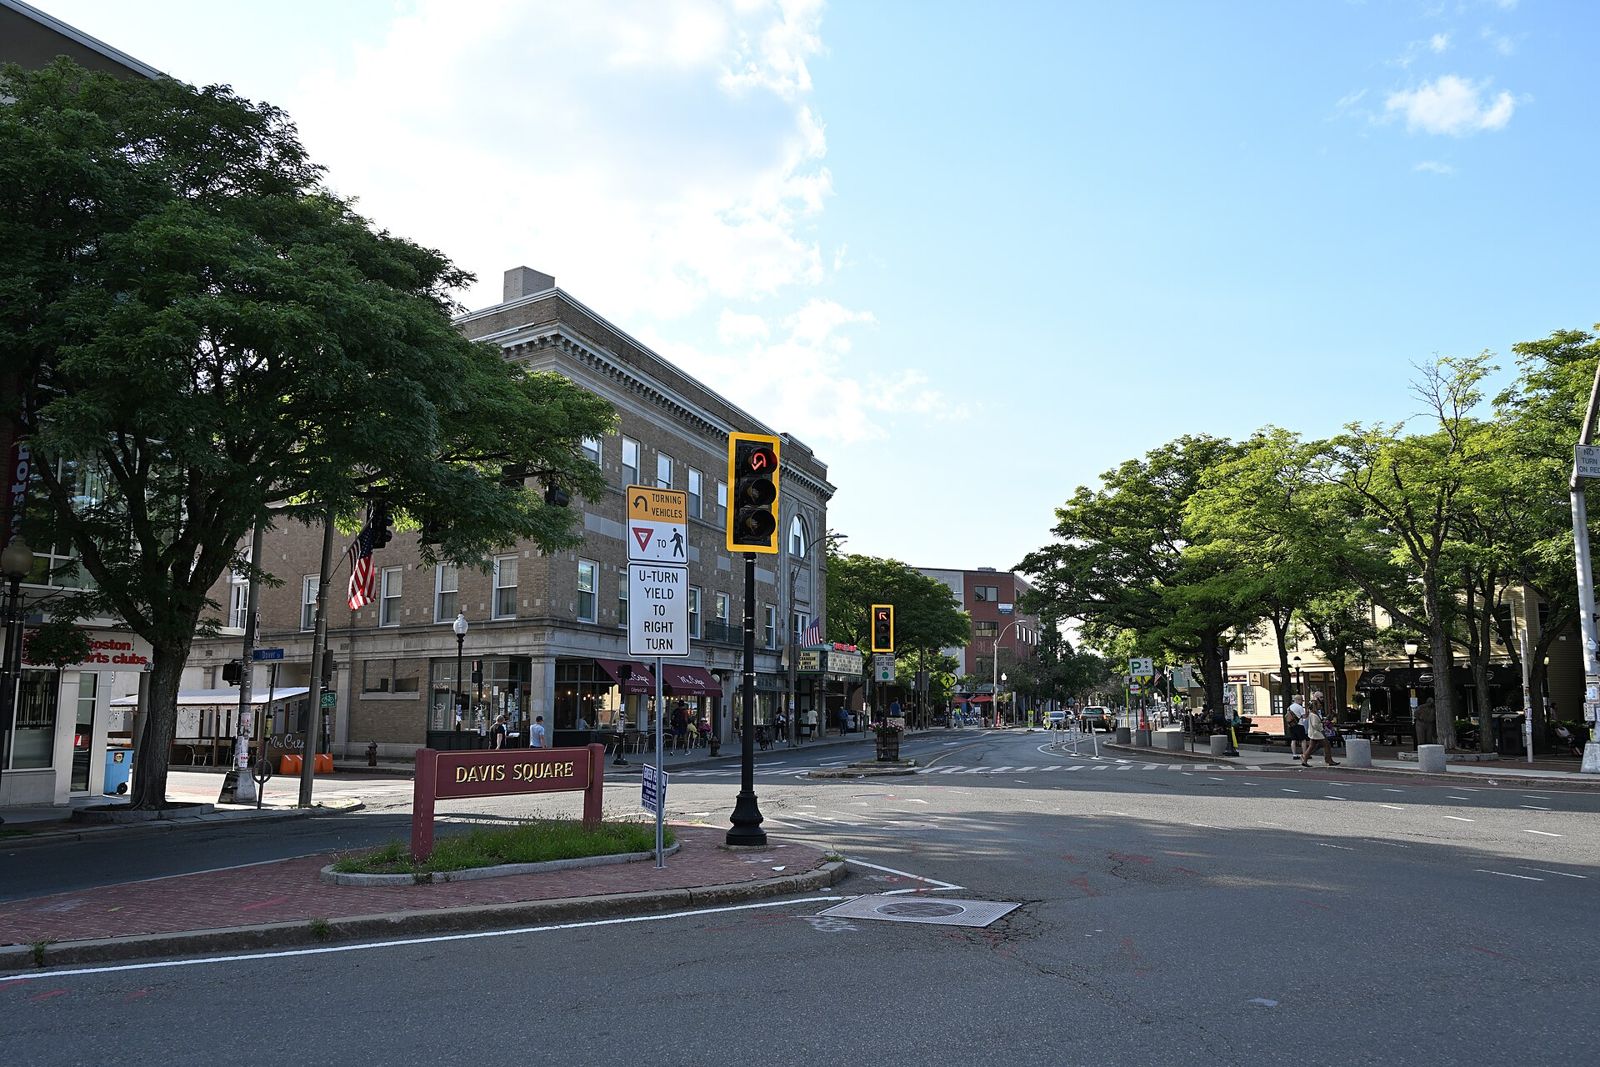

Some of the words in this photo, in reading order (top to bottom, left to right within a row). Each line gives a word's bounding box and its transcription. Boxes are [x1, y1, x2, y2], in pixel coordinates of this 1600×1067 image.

[1583, 448, 1594, 456] NO
[1582, 457, 1598, 465] TURN
[1579, 465, 1588, 473] ON
[651, 493, 682, 505] TURNING
[651, 507, 683, 519] VEHICLES
[657, 538, 667, 549] TO
[639, 570, 679, 584] U-TURN
[644, 586, 674, 600] YIELD
[653, 604, 666, 616] TO
[644, 621, 674, 634] RIGHT
[646, 638, 673, 651] TURN
[112, 652, 147, 665] clubs
[455, 764, 506, 783] DAVIS
[512, 761, 574, 783] SQUARE
